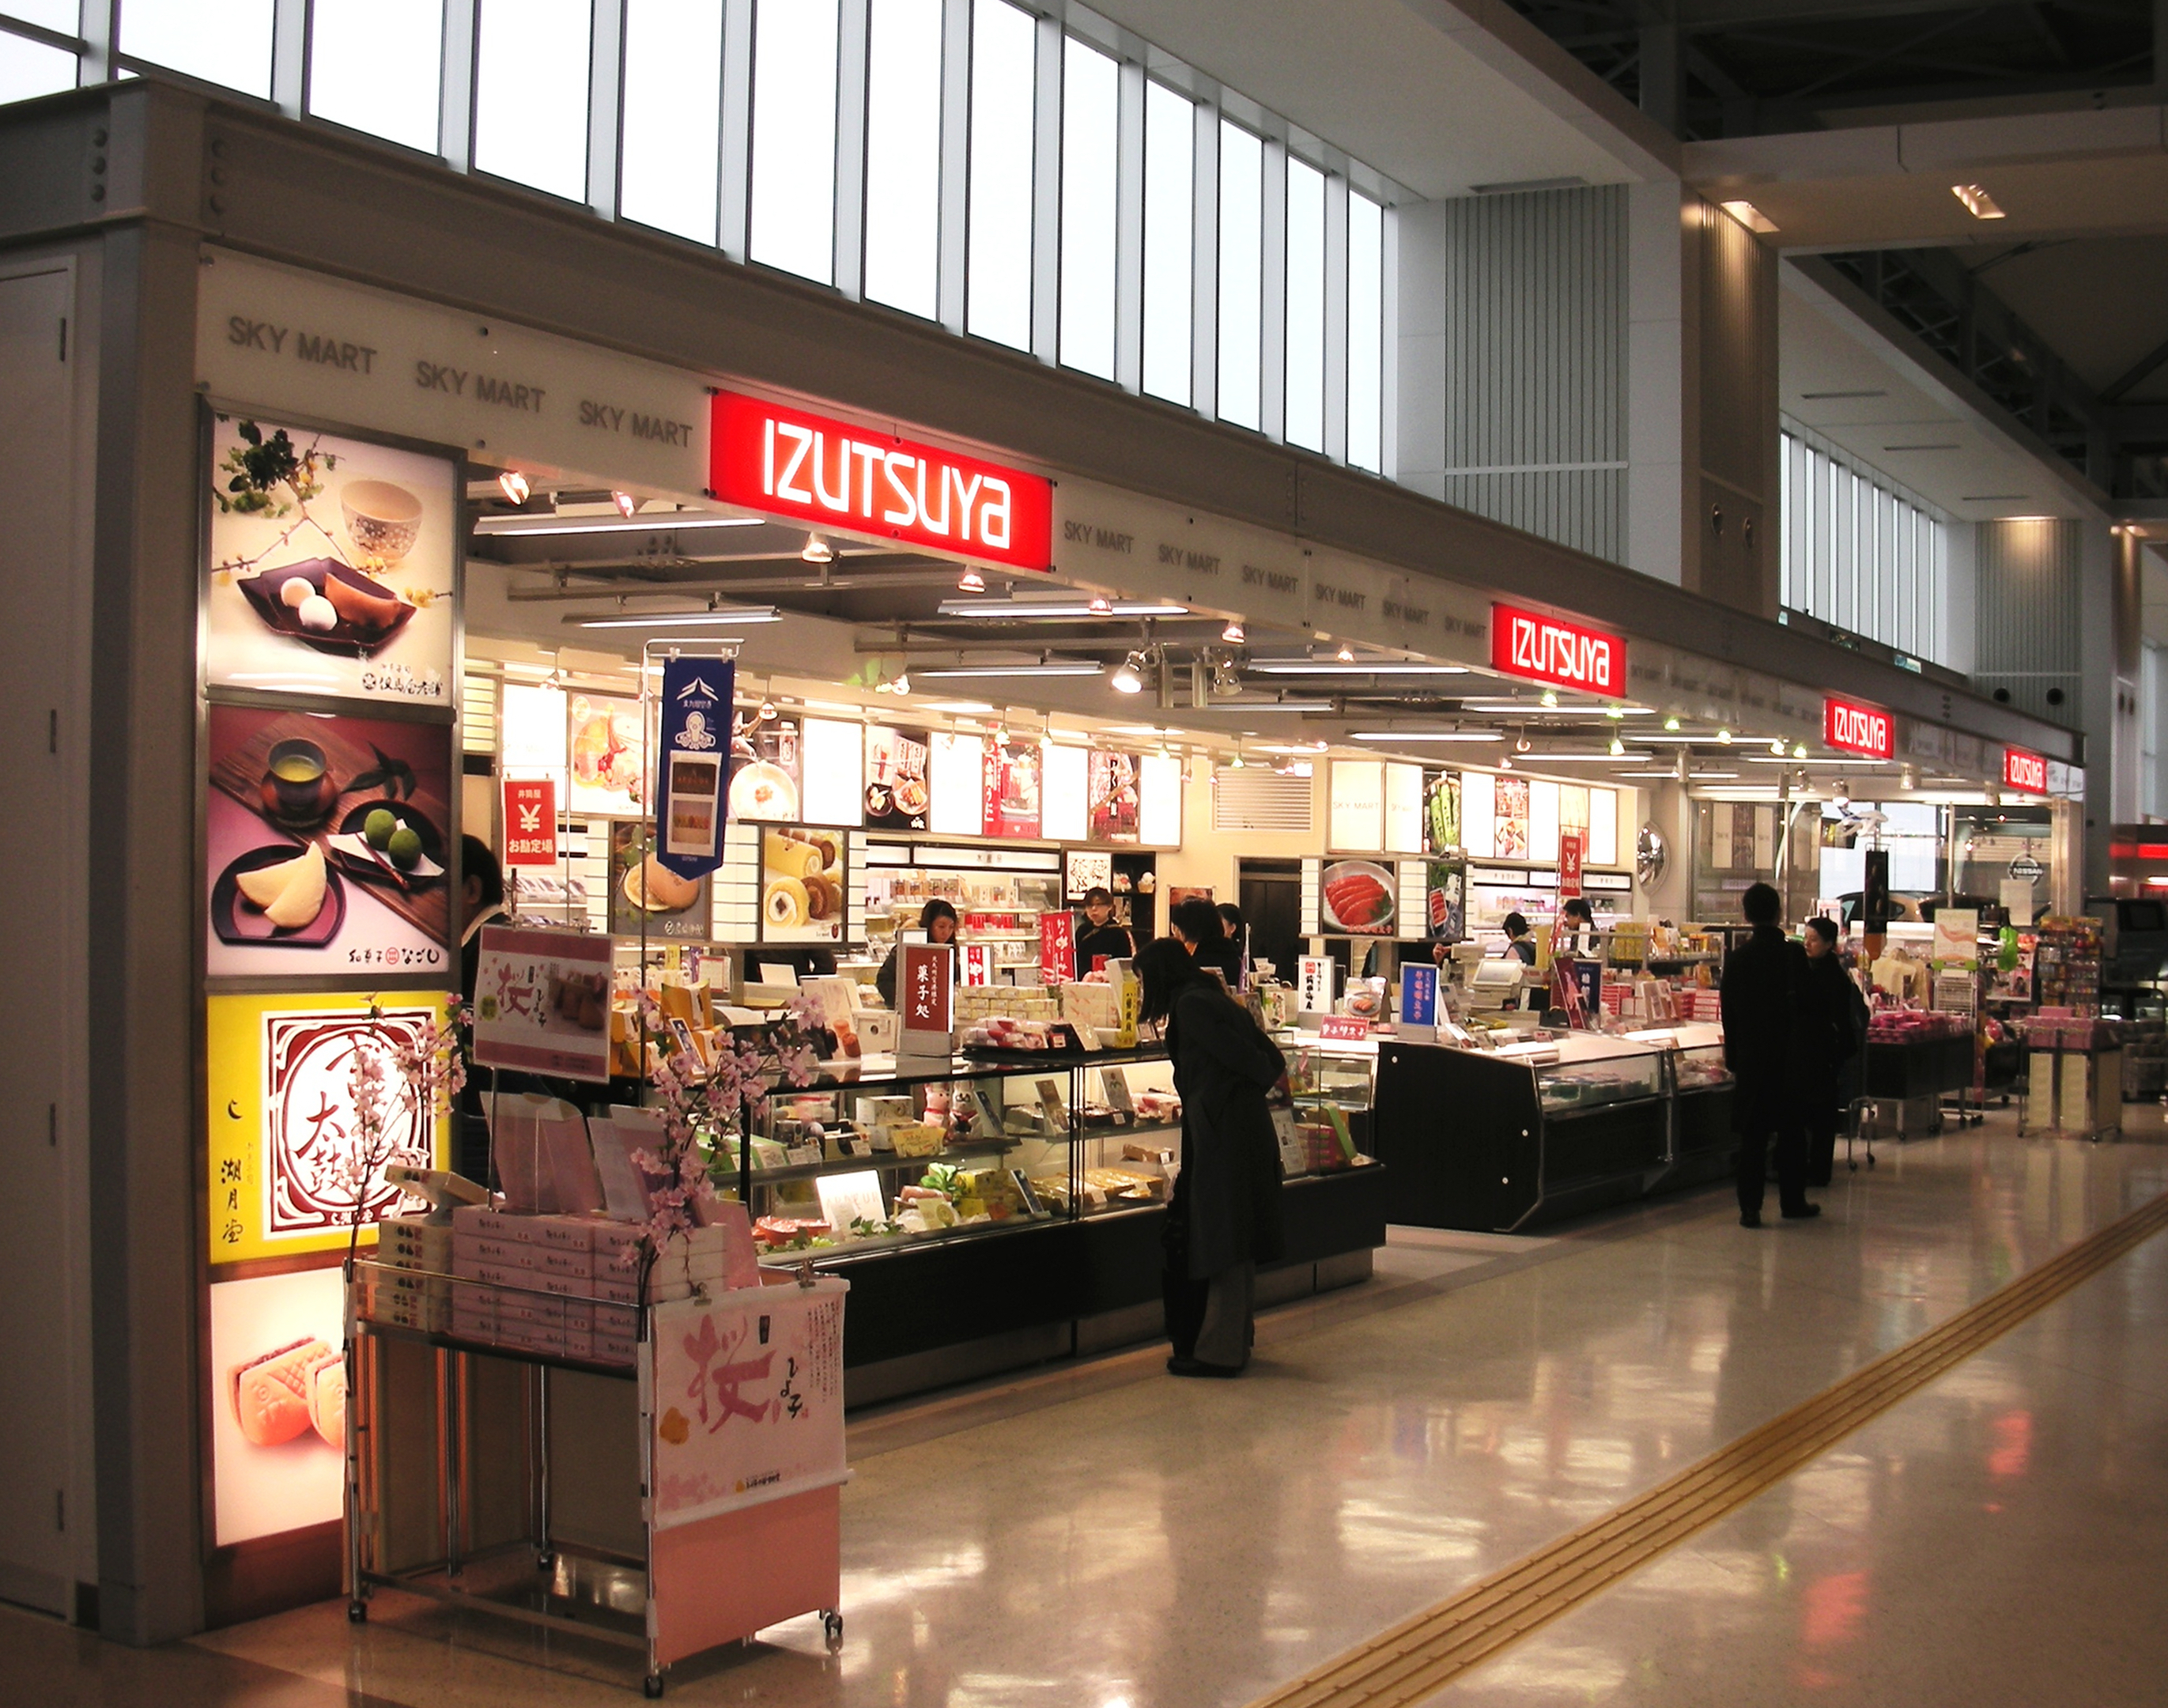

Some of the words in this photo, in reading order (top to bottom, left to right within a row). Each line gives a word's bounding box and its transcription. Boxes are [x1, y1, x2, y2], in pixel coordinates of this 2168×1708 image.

[228, 317, 288, 353] SKY
[297, 331, 377, 374] MART
[416, 361, 467, 395] SKY
[477, 374, 546, 413] MART
[579, 400, 625, 432] SKY
[633, 414, 693, 448] MART
[1064, 520, 1092, 544] SKY
[1097, 528, 1134, 554] MART
[1158, 543, 1183, 566] SKY
[1186, 551, 1220, 576] MART
[1242, 565, 1265, 587] SKY
[1268, 570, 1298, 594] MART
[1316, 584, 1336, 603] SKY
[1339, 588, 1365, 610] MART
[1383, 600, 1402, 619] SKY
[1404, 605, 1430, 625] MART
[518, 789, 542, 799] 井筒屋
[1333, 801, 1350, 810] SKY
[1354, 802, 1379, 811] MART
[518, 803, 542, 832] ¥
[508, 838, 553, 854] お勘定場
[2013, 867, 2044, 876] NISSAN
[916, 964, 930, 1018] 菓子処
[295, 1091, 346, 1197] 太鼓
[221, 1158, 244, 1243] 湖月堂
